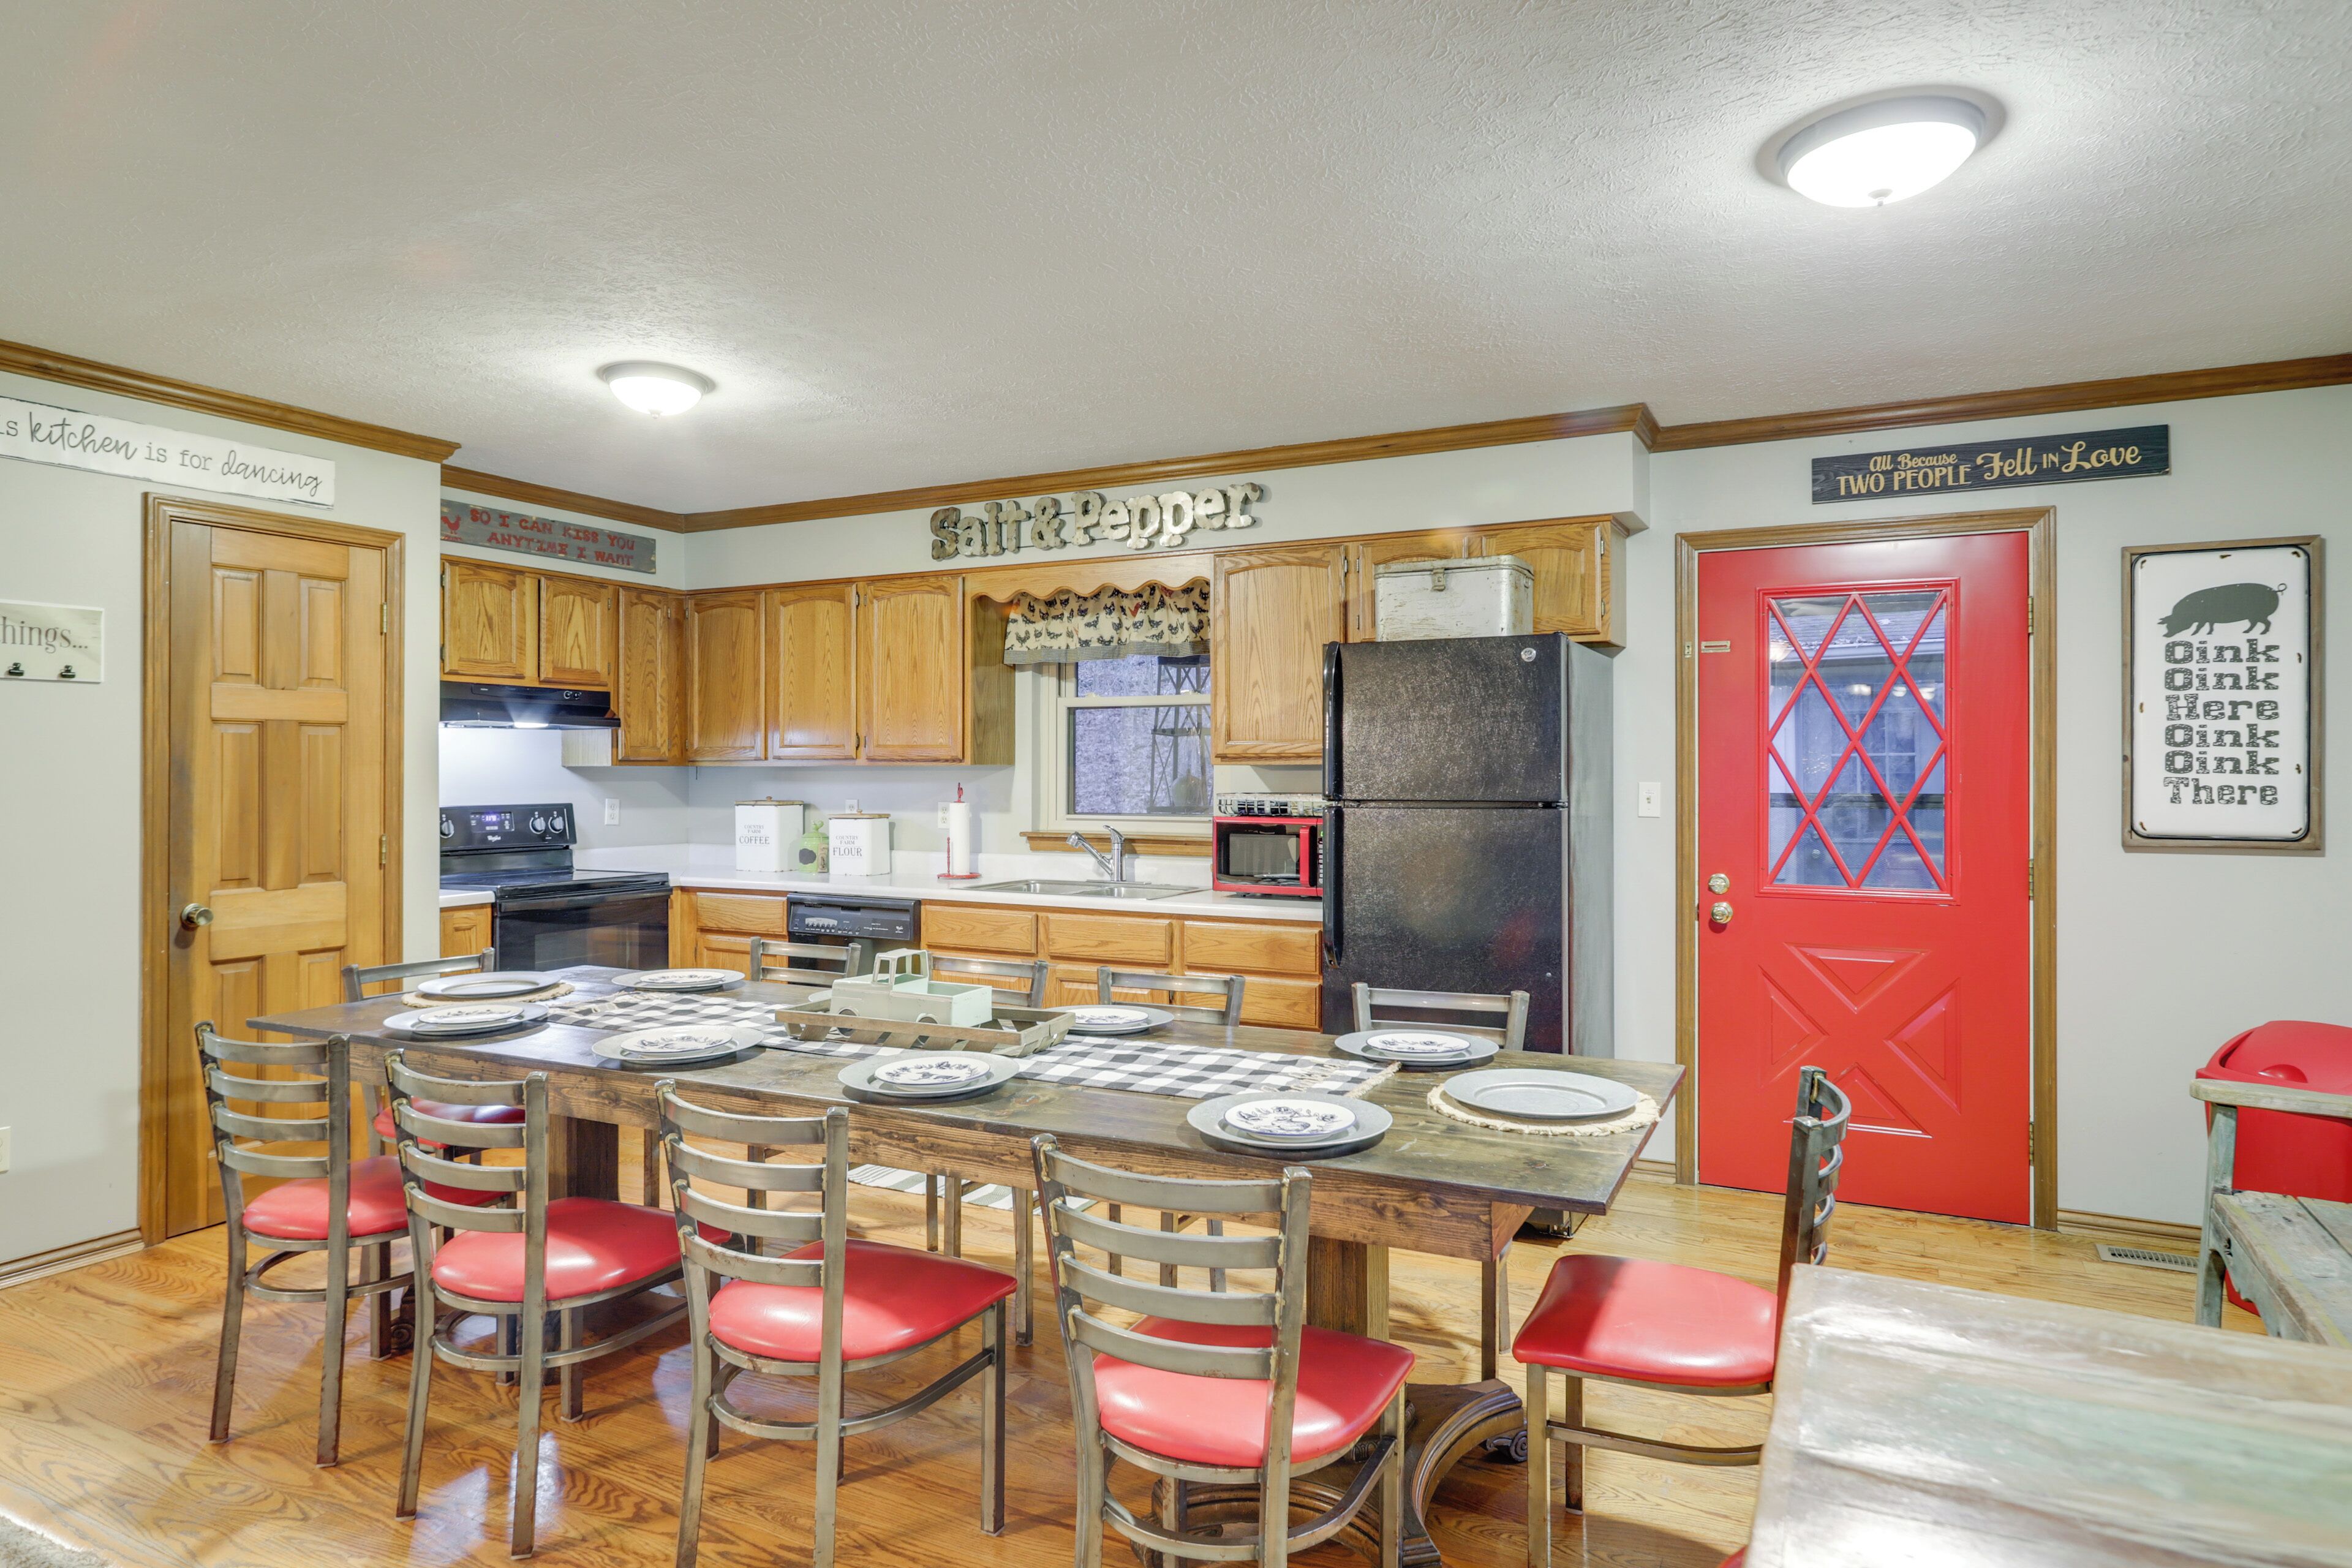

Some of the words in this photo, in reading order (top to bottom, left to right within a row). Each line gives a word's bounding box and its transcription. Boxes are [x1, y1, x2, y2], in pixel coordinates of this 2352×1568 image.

[29, 412, 137, 460] kitchen
[144, 442, 167, 463] is
[179, 450, 213, 471] for
[221, 450, 323, 497] dancing
[1898, 453, 1958, 470] Because
[1976, 447, 2037, 480] Fell
[2043, 452, 2059, 469] IN
[2060, 440, 2143, 473] Love
[1836, 473, 1885, 496] TWO
[1893, 464, 1972, 491] PEOPLE
[470, 508, 491, 526] SO
[499, 514, 510, 527] I
[519, 518, 552, 534] CAN
[562, 526, 598, 543] KISS
[607, 533, 635, 550] YOU
[930, 499, 1031, 561] Salt
[1030, 496, 1067, 550] &
[1071, 481, 1264, 550] Pepper
[487, 532, 568, 556] ANYTIME
[576, 546, 586, 559] I
[0, 616, 88, 654] hings...
[2165, 639, 2279, 664] Oink
[2165, 666, 2279, 692] Oink
[2165, 693, 2279, 721] Here
[2165, 723, 2279, 748] Oink
[2165, 750, 2279, 774] Oink
[2163, 777, 2278, 805] There
[739, 835, 770, 845] COFFEE
[832, 847, 862, 857] FLOUR
